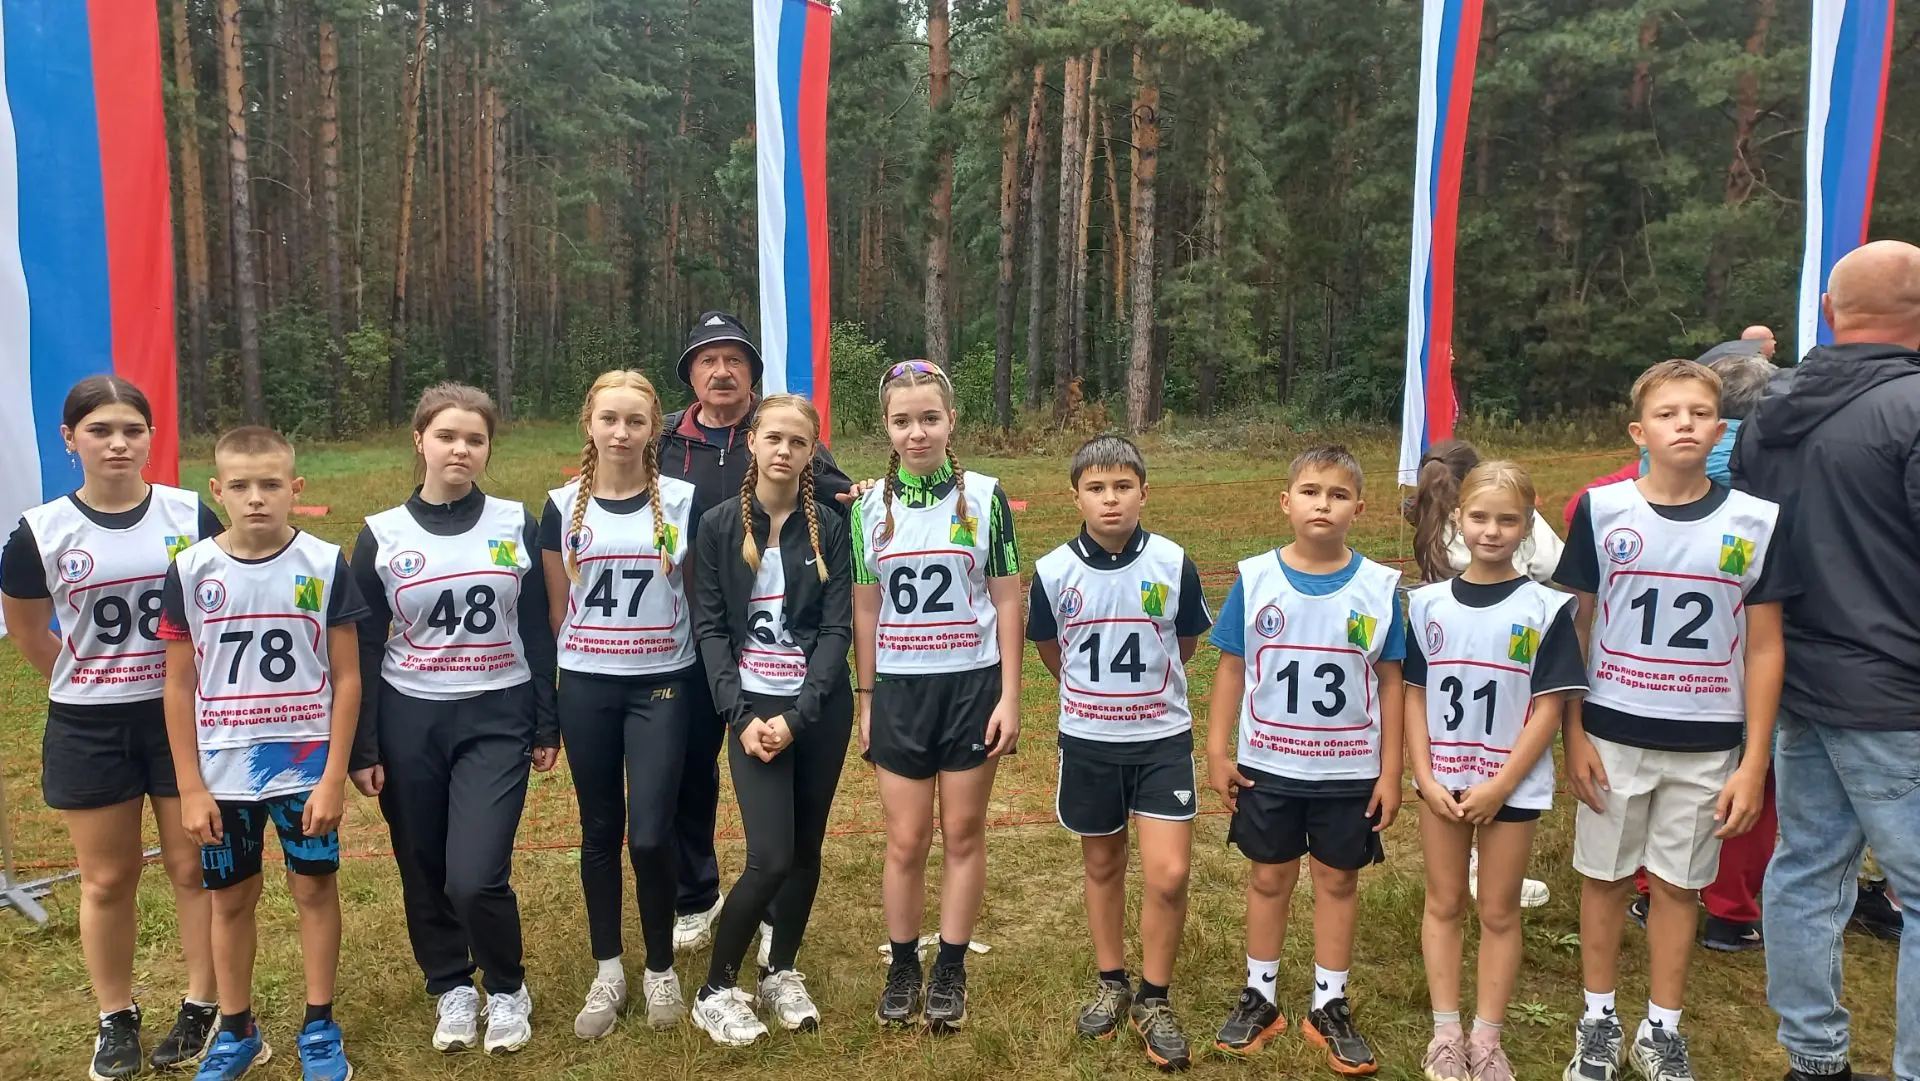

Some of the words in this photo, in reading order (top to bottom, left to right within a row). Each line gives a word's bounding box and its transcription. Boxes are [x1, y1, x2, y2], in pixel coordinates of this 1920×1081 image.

[427, 584, 496, 636] 48
[585, 569, 653, 617] 47
[889, 564, 954, 615] 62
[93, 589, 164, 645] 98
[1631, 588, 1714, 650] 12
[71, 676, 88, 684] МО
[74, 663, 151, 675] Ульяновская
[220, 628, 296, 684] 78
[1078, 632, 1147, 682] 14
[1600, 660, 1675, 681] Ульяновская
[1679, 673, 1729, 683] область
[1277, 660, 1347, 718] 13
[1440, 675, 1497, 736] 31
[1596, 670, 1613, 681] МО
[1615, 675, 1692, 693] «Барышский
[1694, 685, 1732, 695] район»
[274, 702, 323, 713] область
[1249, 738, 1264, 749] МО
[1266, 743, 1337, 757] «Барышский
[1338, 748, 1373, 759] район»
[1254, 730, 1321, 747] Ульяновская
[1323, 737, 1369, 748] область
